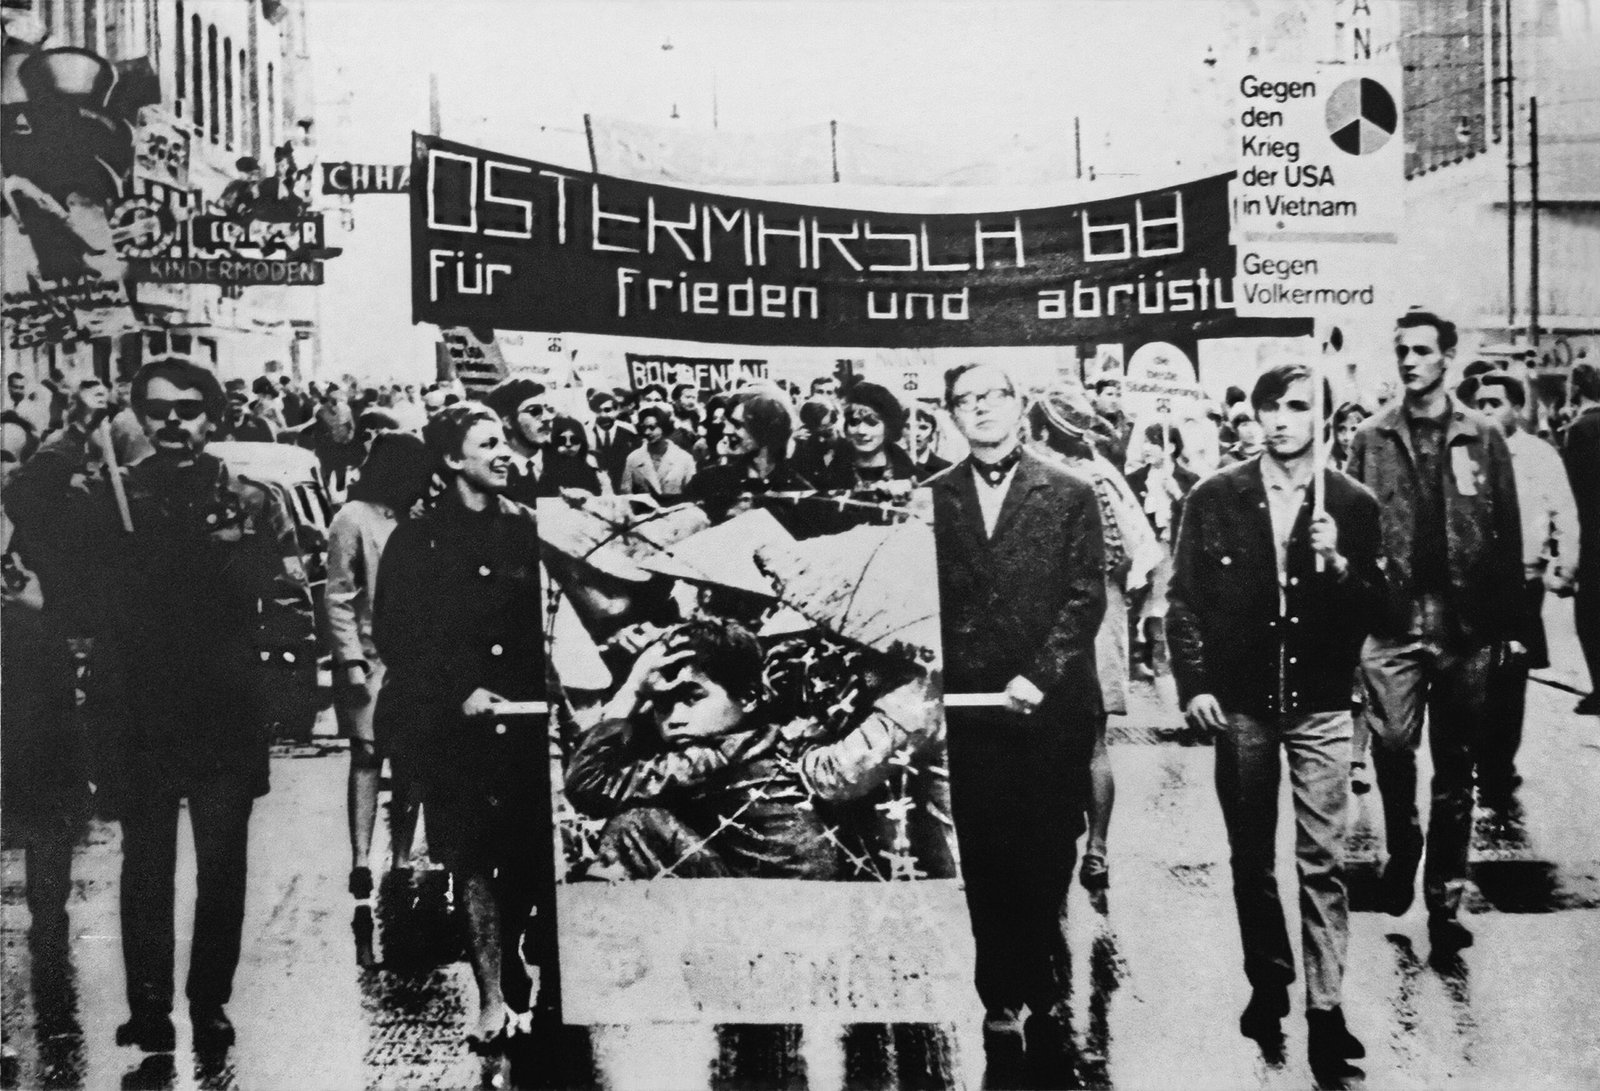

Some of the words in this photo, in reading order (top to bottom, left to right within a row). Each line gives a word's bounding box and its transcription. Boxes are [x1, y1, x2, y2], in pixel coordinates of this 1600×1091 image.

[1239, 74, 1316, 104] Gegen
[1240, 106, 1284, 128] den
[1241, 134, 1300, 163] Krieg
[1242, 165, 1279, 187] der
[1284, 164, 1336, 188] USA
[1243, 194, 1261, 215] in
[1264, 194, 1358, 217] Vietnam
[149, 259, 316, 282] KINDERMODEN
[1242, 252, 1319, 281] Gegen
[867, 286, 970, 321] und
